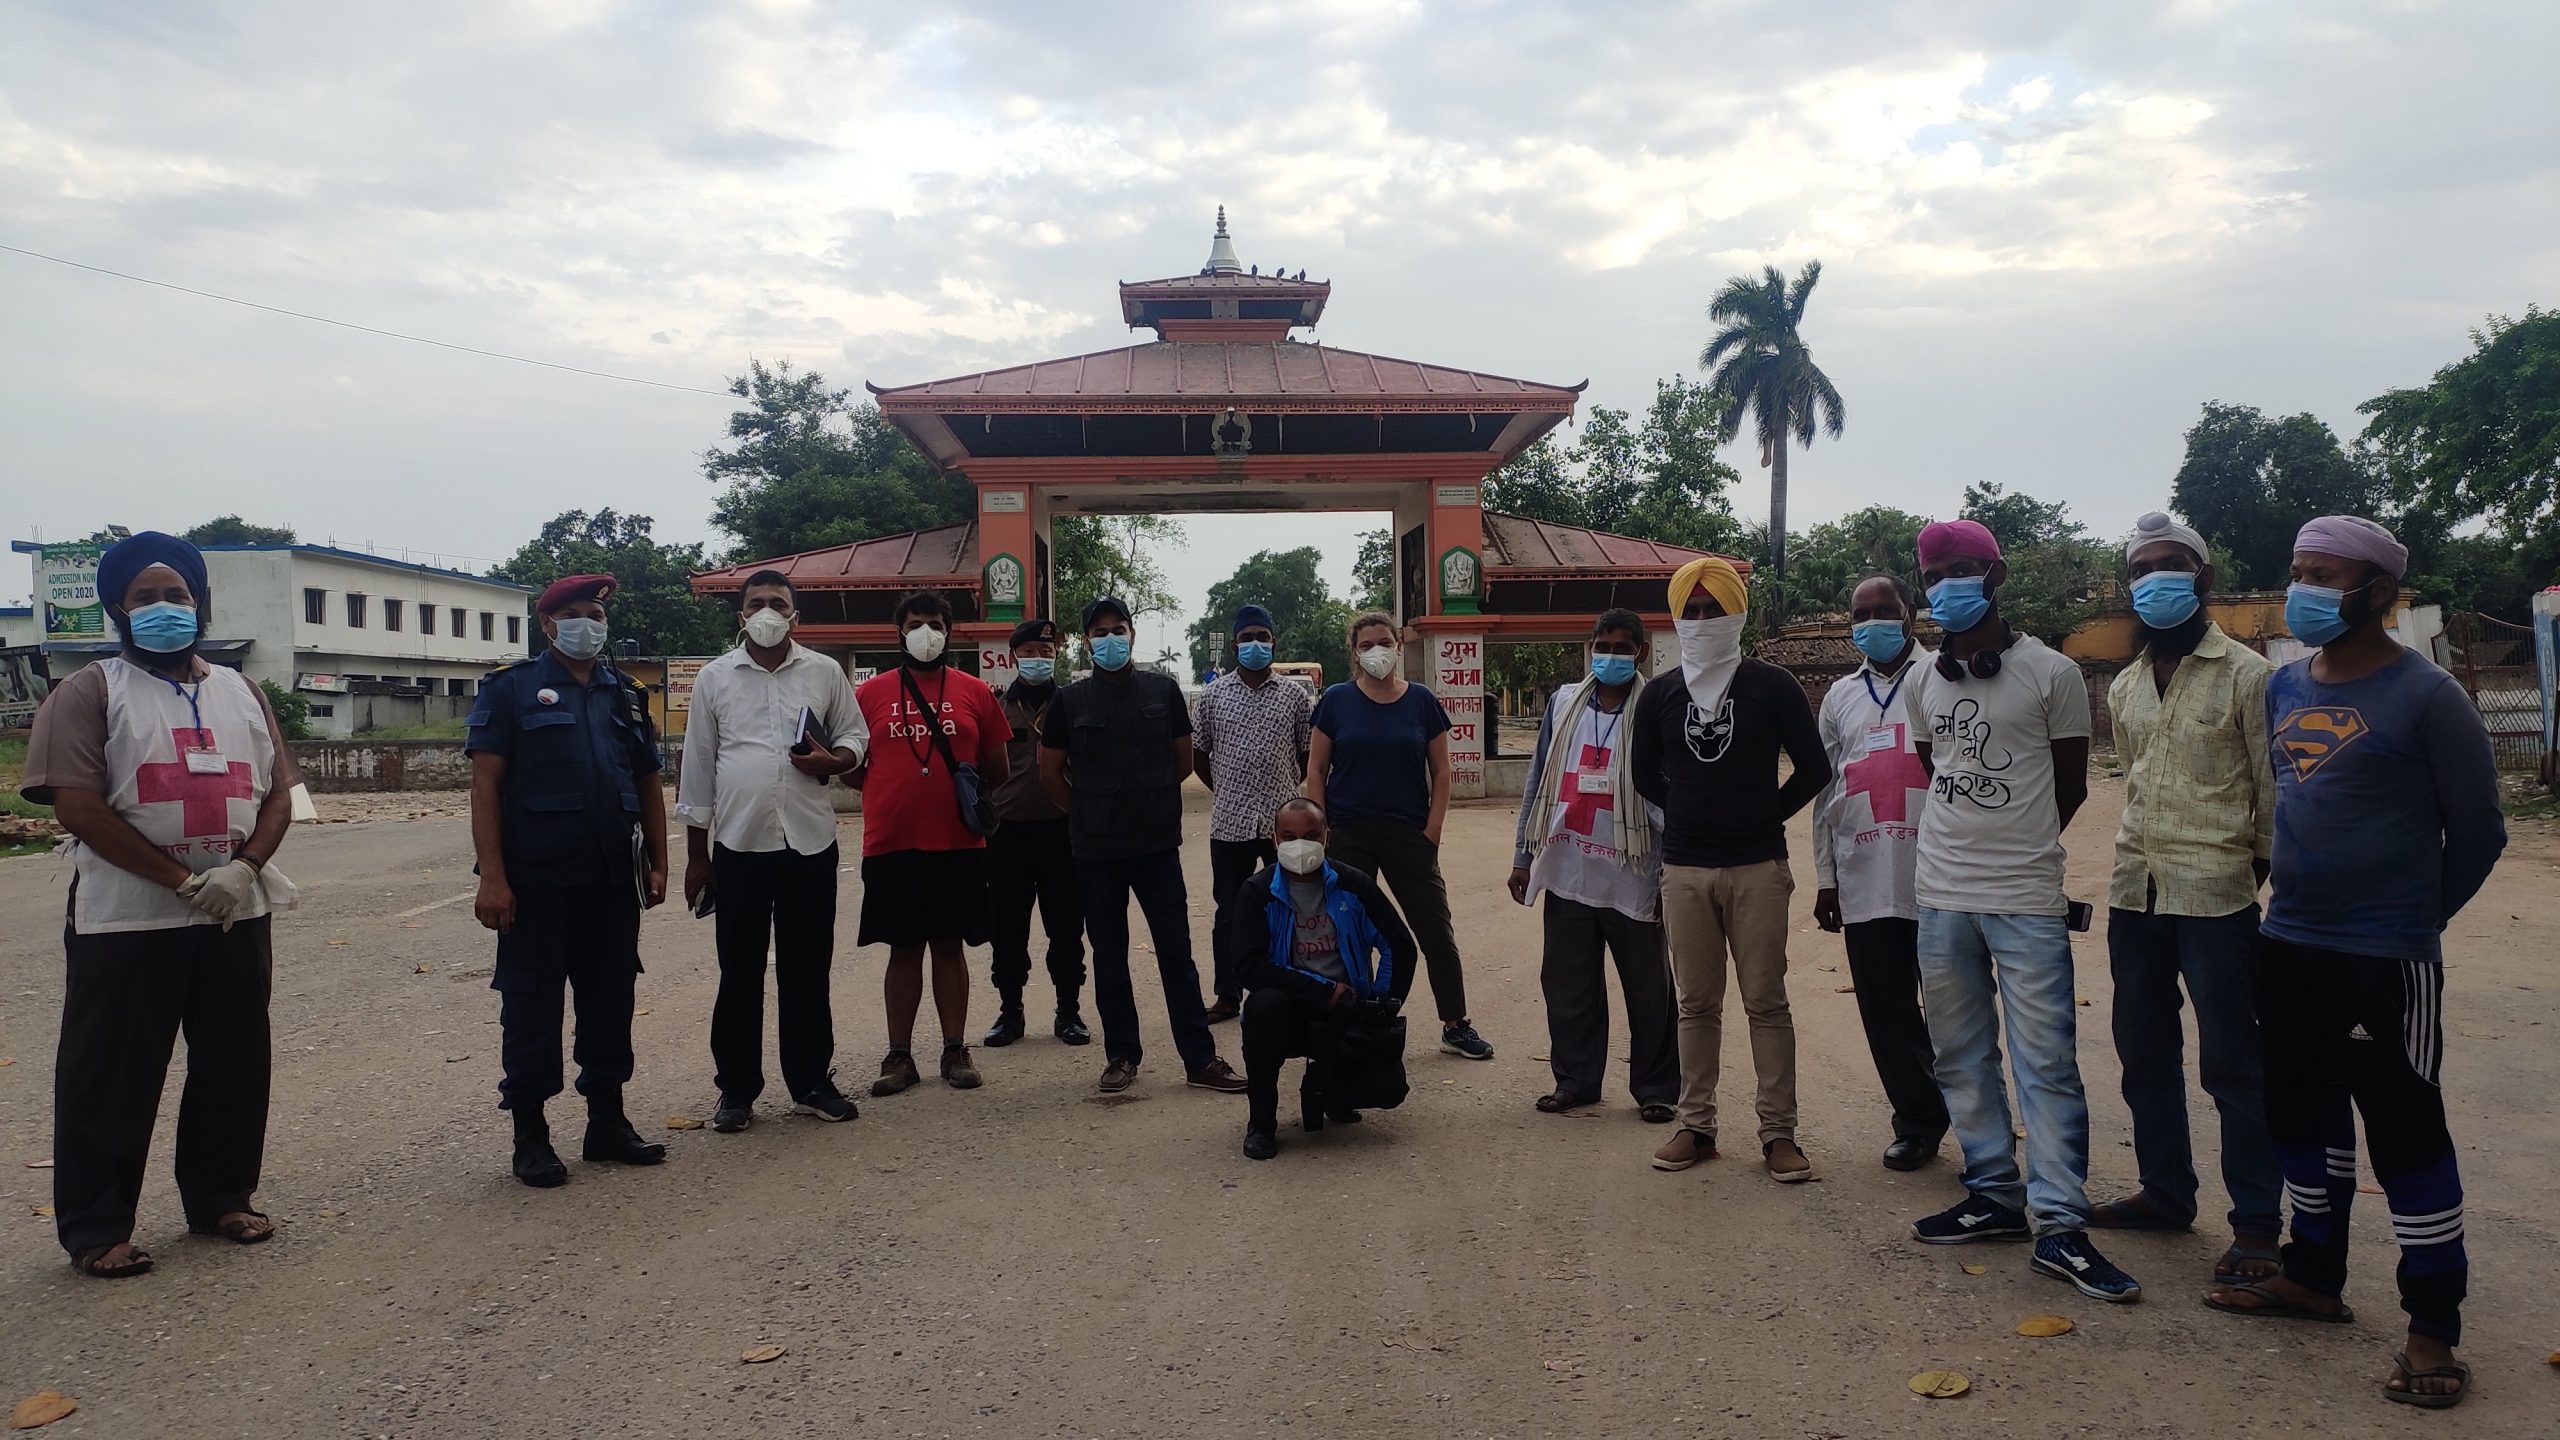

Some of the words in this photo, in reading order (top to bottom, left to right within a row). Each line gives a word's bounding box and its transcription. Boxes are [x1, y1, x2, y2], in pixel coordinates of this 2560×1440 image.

[48, 573, 81, 585] ADMISSION
[82, 572, 96, 584] NOW
[52, 587, 73, 600] OPEN
[75, 586, 94, 599] 2020
[1441, 641, 1477, 664] शुभ
[1441, 669, 1481, 686] यात्रा
[891, 702, 899, 717] I
[906, 700, 954, 715] Lve
[888, 719, 957, 742] Kopa
[1450, 724, 1475, 741] उप
[1449, 752, 1481, 767] हानगर
[1294, 911, 1328, 930] Lov
[1296, 935, 1338, 961] opil
